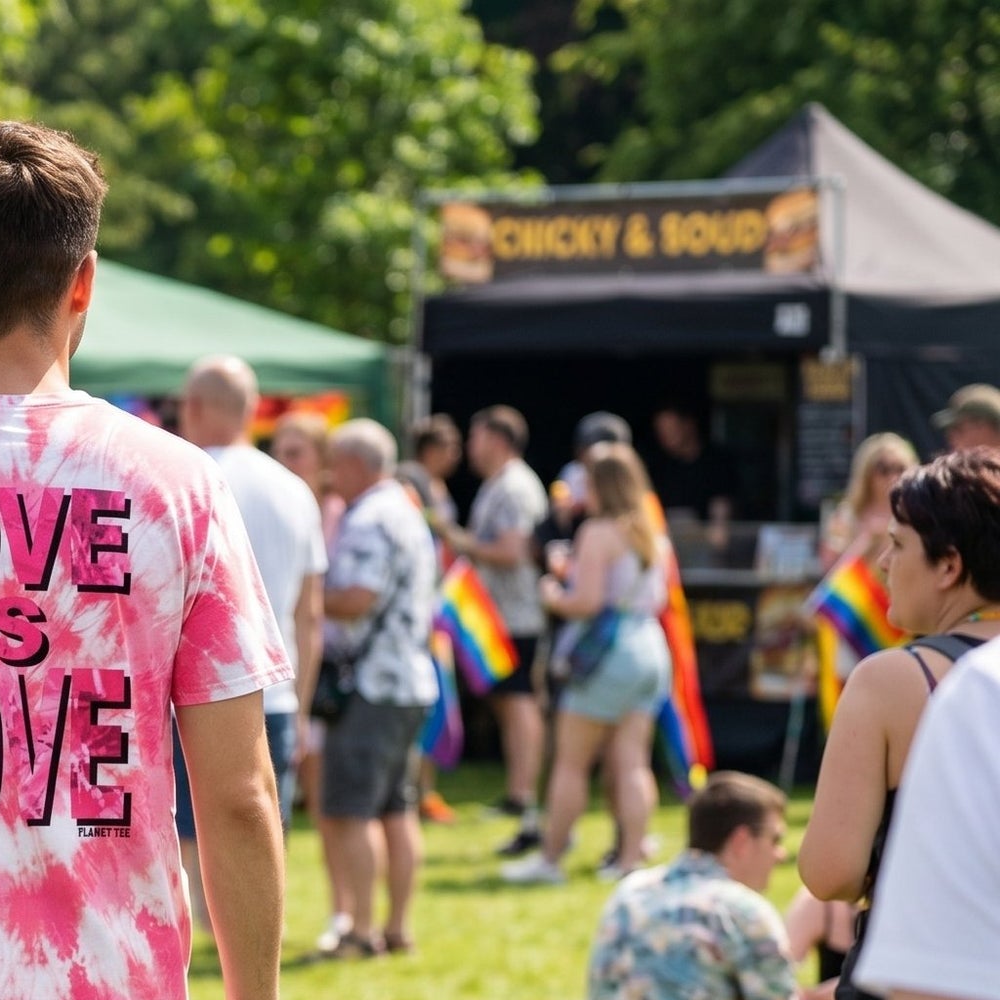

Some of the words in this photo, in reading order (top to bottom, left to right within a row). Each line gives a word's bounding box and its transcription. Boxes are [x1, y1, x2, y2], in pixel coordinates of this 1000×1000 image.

[624, 211, 655, 258] &
[78, 827, 112, 838] PLANET
[113, 827, 131, 838] TEE
